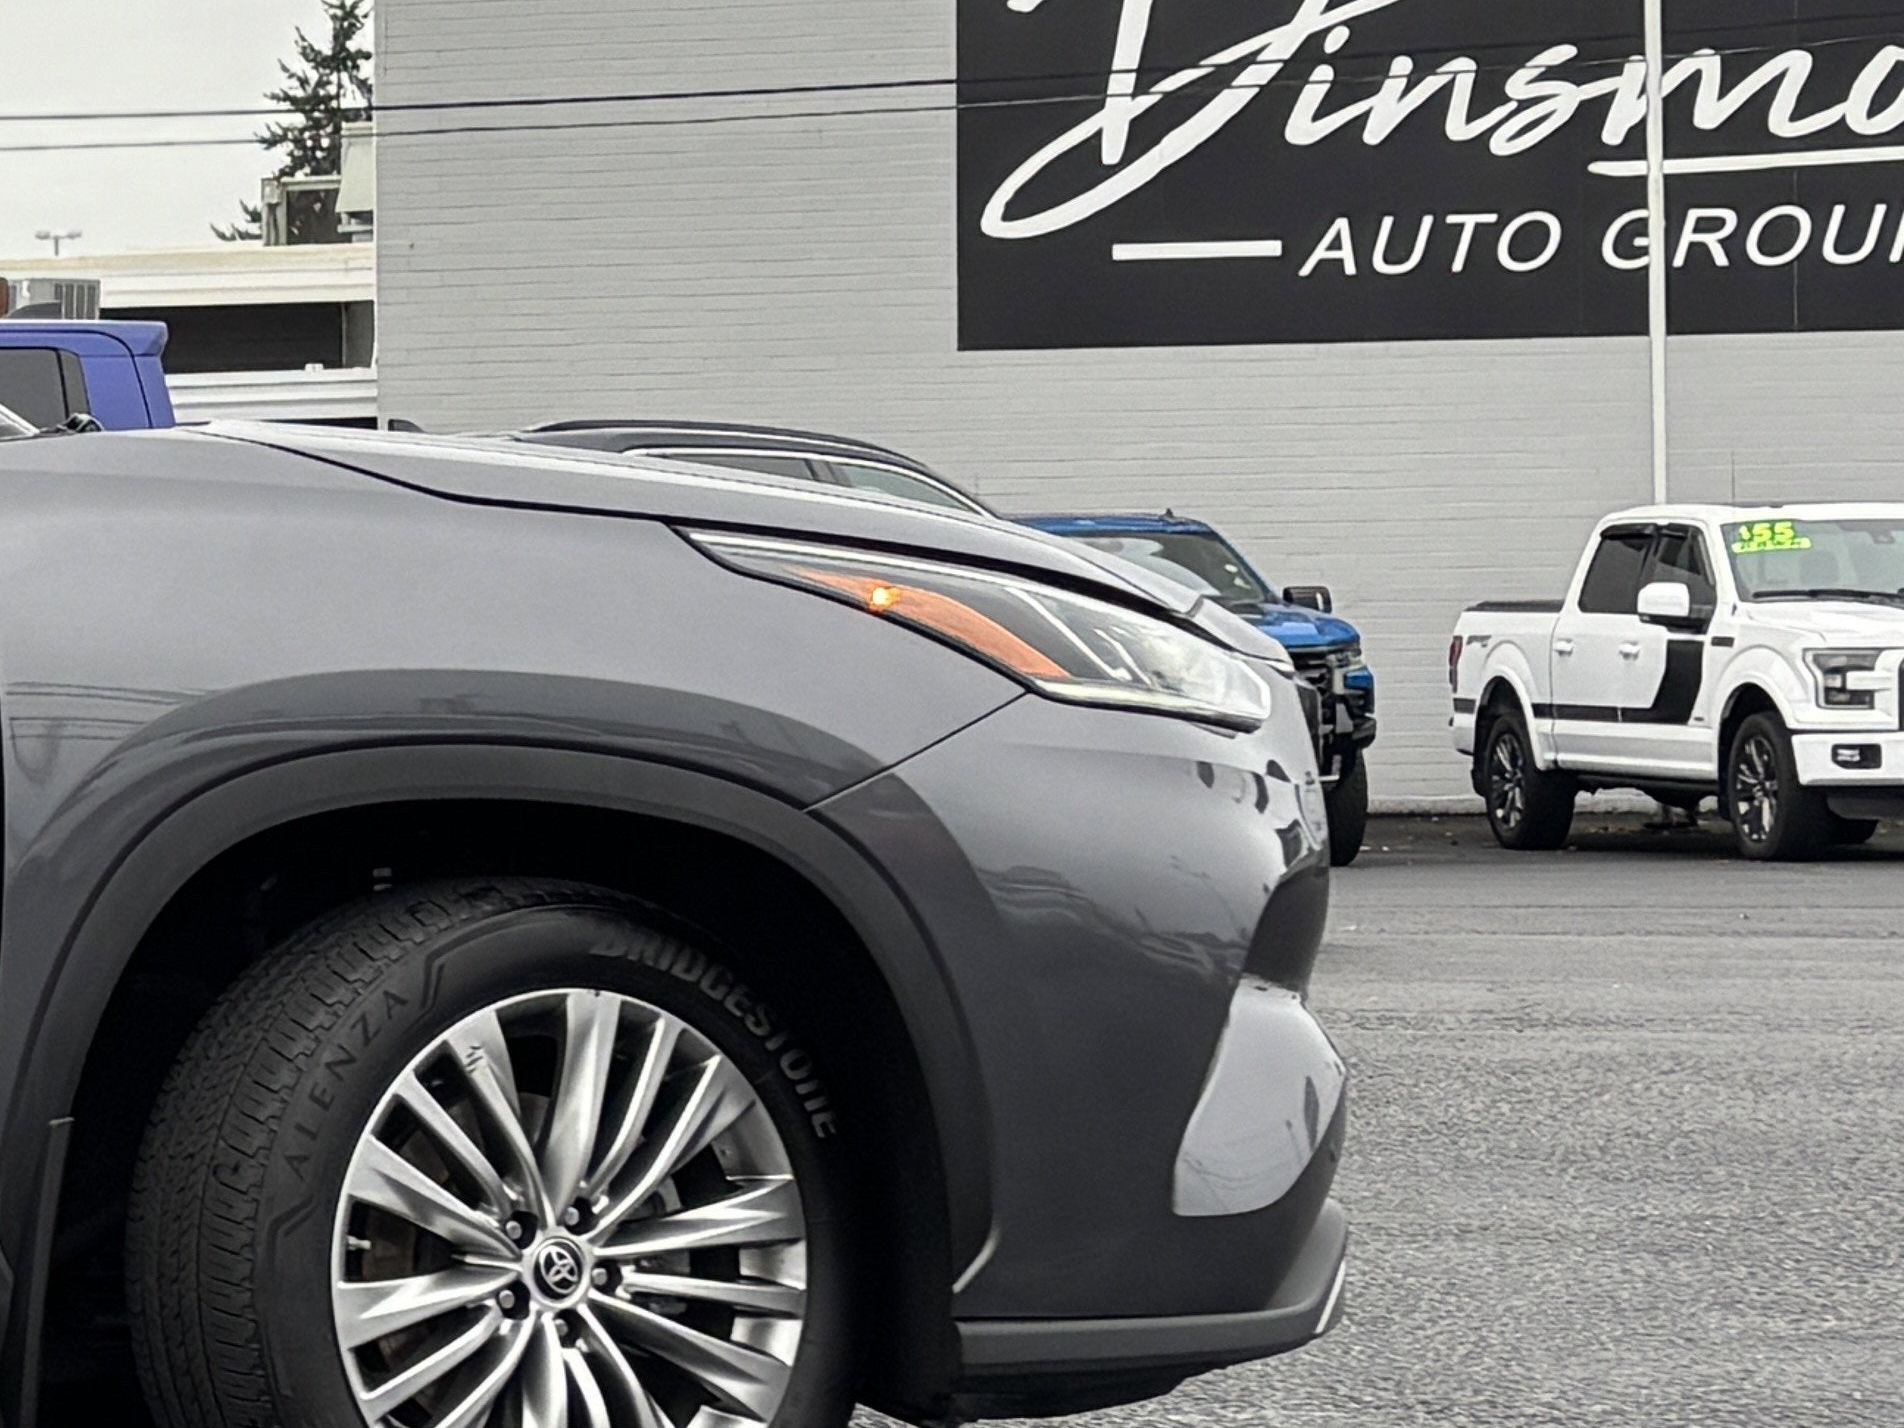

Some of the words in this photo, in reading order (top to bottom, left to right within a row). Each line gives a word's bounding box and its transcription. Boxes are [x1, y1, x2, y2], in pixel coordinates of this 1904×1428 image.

[1300, 210, 1563, 277] AUTO
[1601, 204, 1904, 270] GROU
[283, 990, 410, 1182] ALENZA
